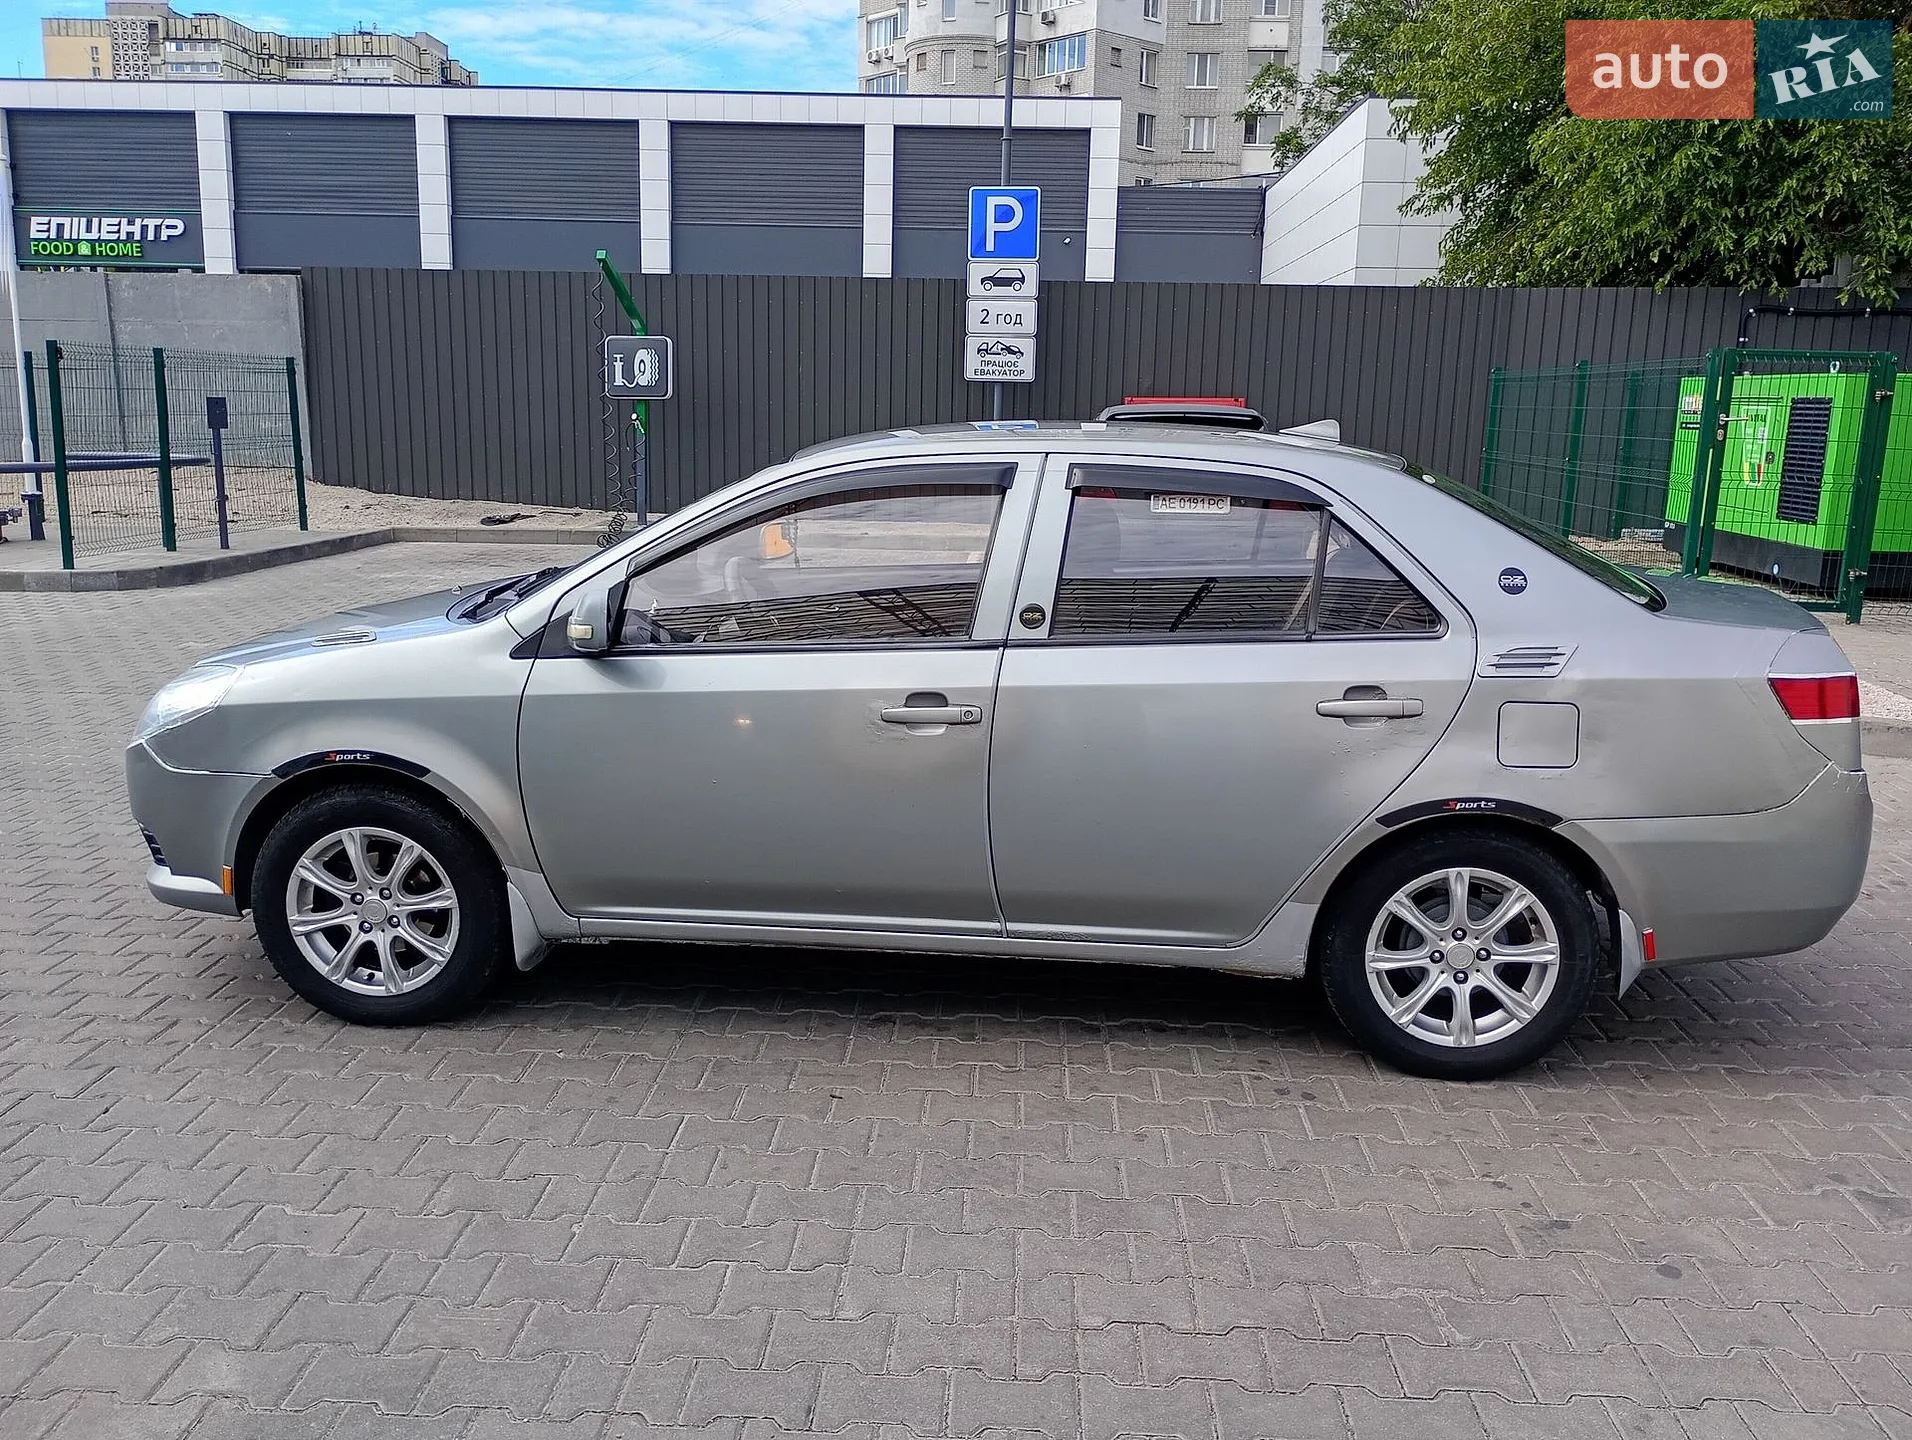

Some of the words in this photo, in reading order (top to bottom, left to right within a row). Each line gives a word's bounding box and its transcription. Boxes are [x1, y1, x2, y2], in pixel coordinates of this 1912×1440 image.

[29, 216, 186, 241] ЕПІЦЕНТР
[985, 196, 1024, 252] P
[30, 241, 74, 255] FOOD
[96, 242, 142, 257] HOME
[979, 308, 990, 325] 2
[996, 313, 1023, 327] год
[974, 368, 1025, 377] ЕВАКУАТОР
[980, 360, 1019, 369] ПРАЦЮЄ
[1160, 497, 1176, 509] AE
[1179, 498, 1205, 509] 0191
